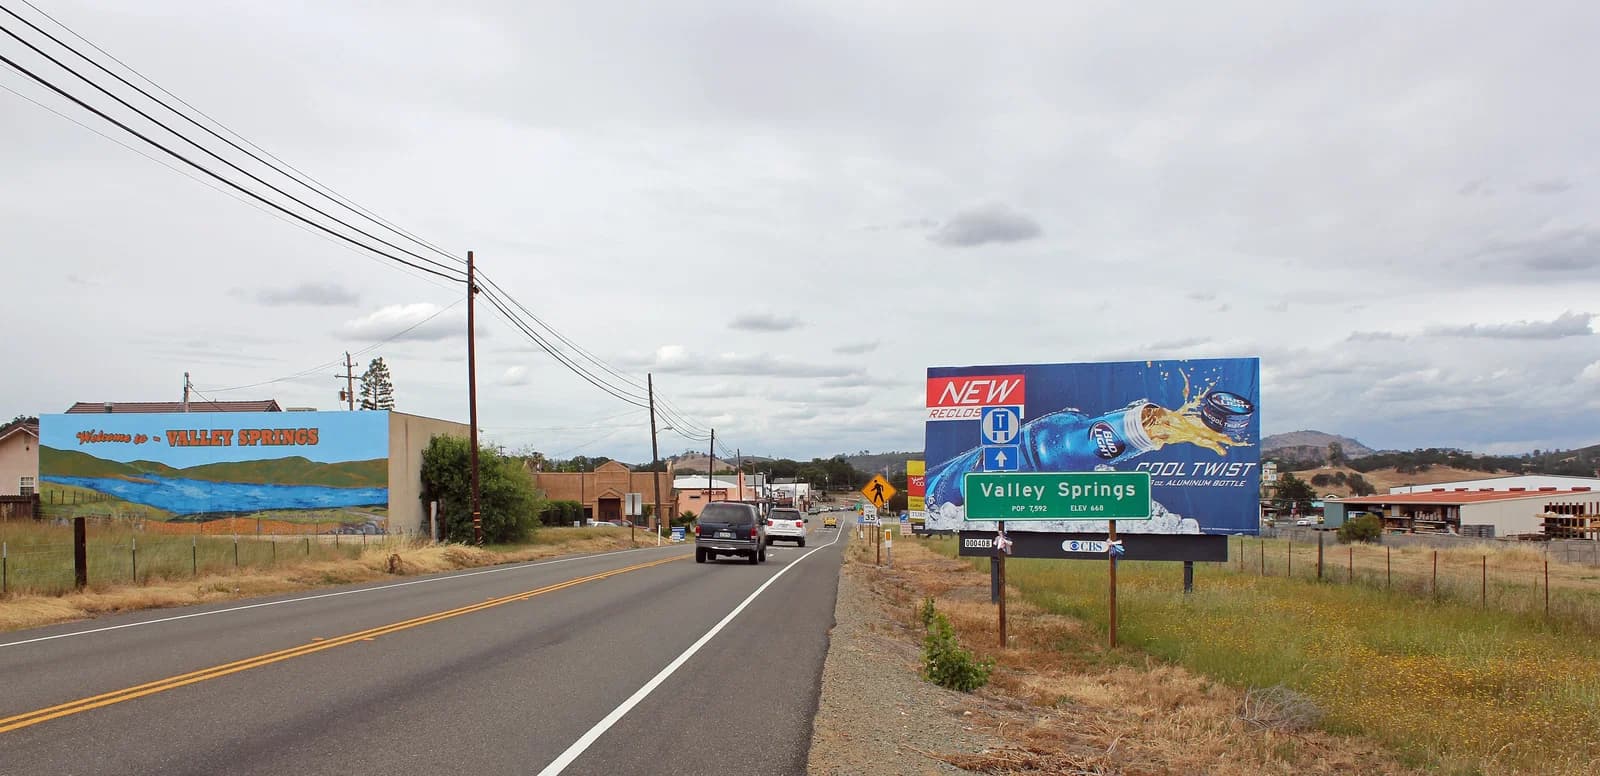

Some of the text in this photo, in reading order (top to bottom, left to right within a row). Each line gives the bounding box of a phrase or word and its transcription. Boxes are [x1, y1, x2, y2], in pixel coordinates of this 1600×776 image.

[938, 379, 1021, 405] NEW
[76, 430, 131, 445] Welcome
[134, 434, 148, 444] to
[166, 429, 234, 447] VALLEY
[238, 428, 319, 446] SPRINGS
[1095, 428, 1113, 458] LIGHT
[1103, 430, 1118, 453] BUD
[1135, 462, 1186, 476] COOL
[1191, 462, 1256, 477] TWIST
[980, 482, 1136, 501] Valley Springs
[1165, 479, 1211, 487] ALUMINUM
[1212, 479, 1247, 487] BOTTLE
[1028, 505, 1048, 513] 7,592
[1070, 504, 1088, 512] ELEV
[1080, 541, 1103, 550] CBS
